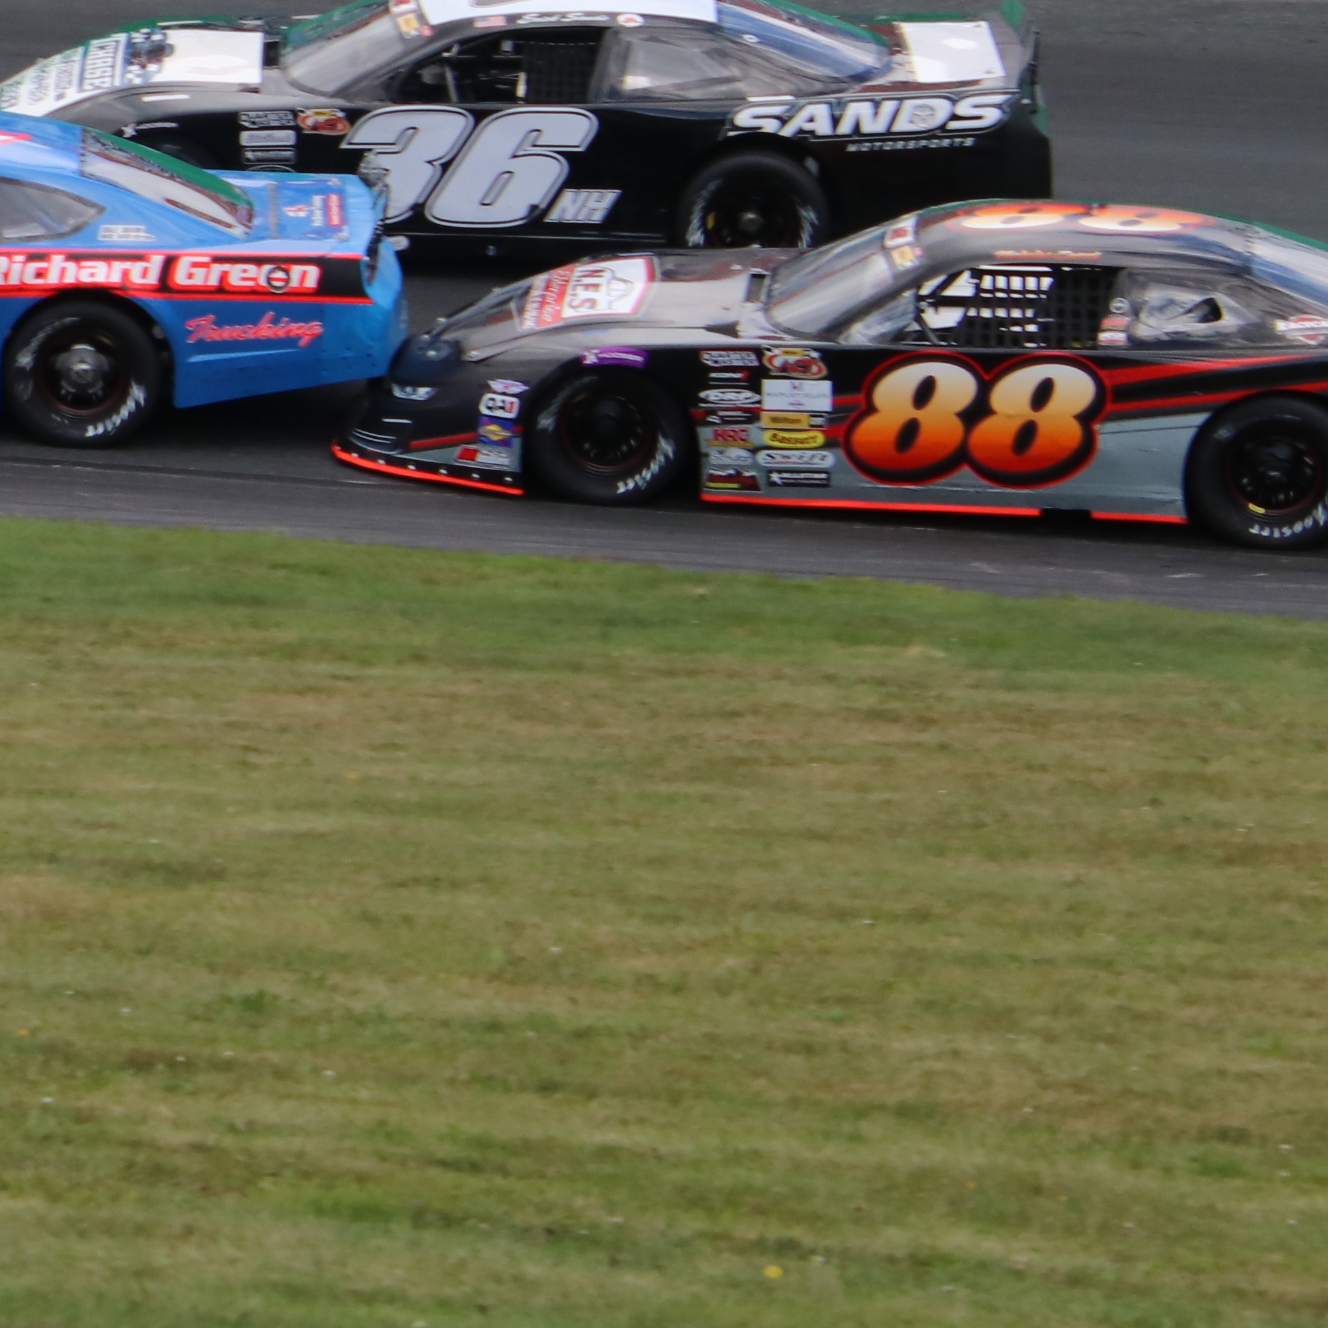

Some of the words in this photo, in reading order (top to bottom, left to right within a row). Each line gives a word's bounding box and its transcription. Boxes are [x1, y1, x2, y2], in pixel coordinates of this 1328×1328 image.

[729, 94, 1017, 138] SANDS
[847, 137, 975, 153] MOTORSPORTS
[545, 188, 622, 224] NH
[172, 255, 321, 294] Green
[185, 311, 324, 348] Trucking
[847, 357, 1101, 482] 88
